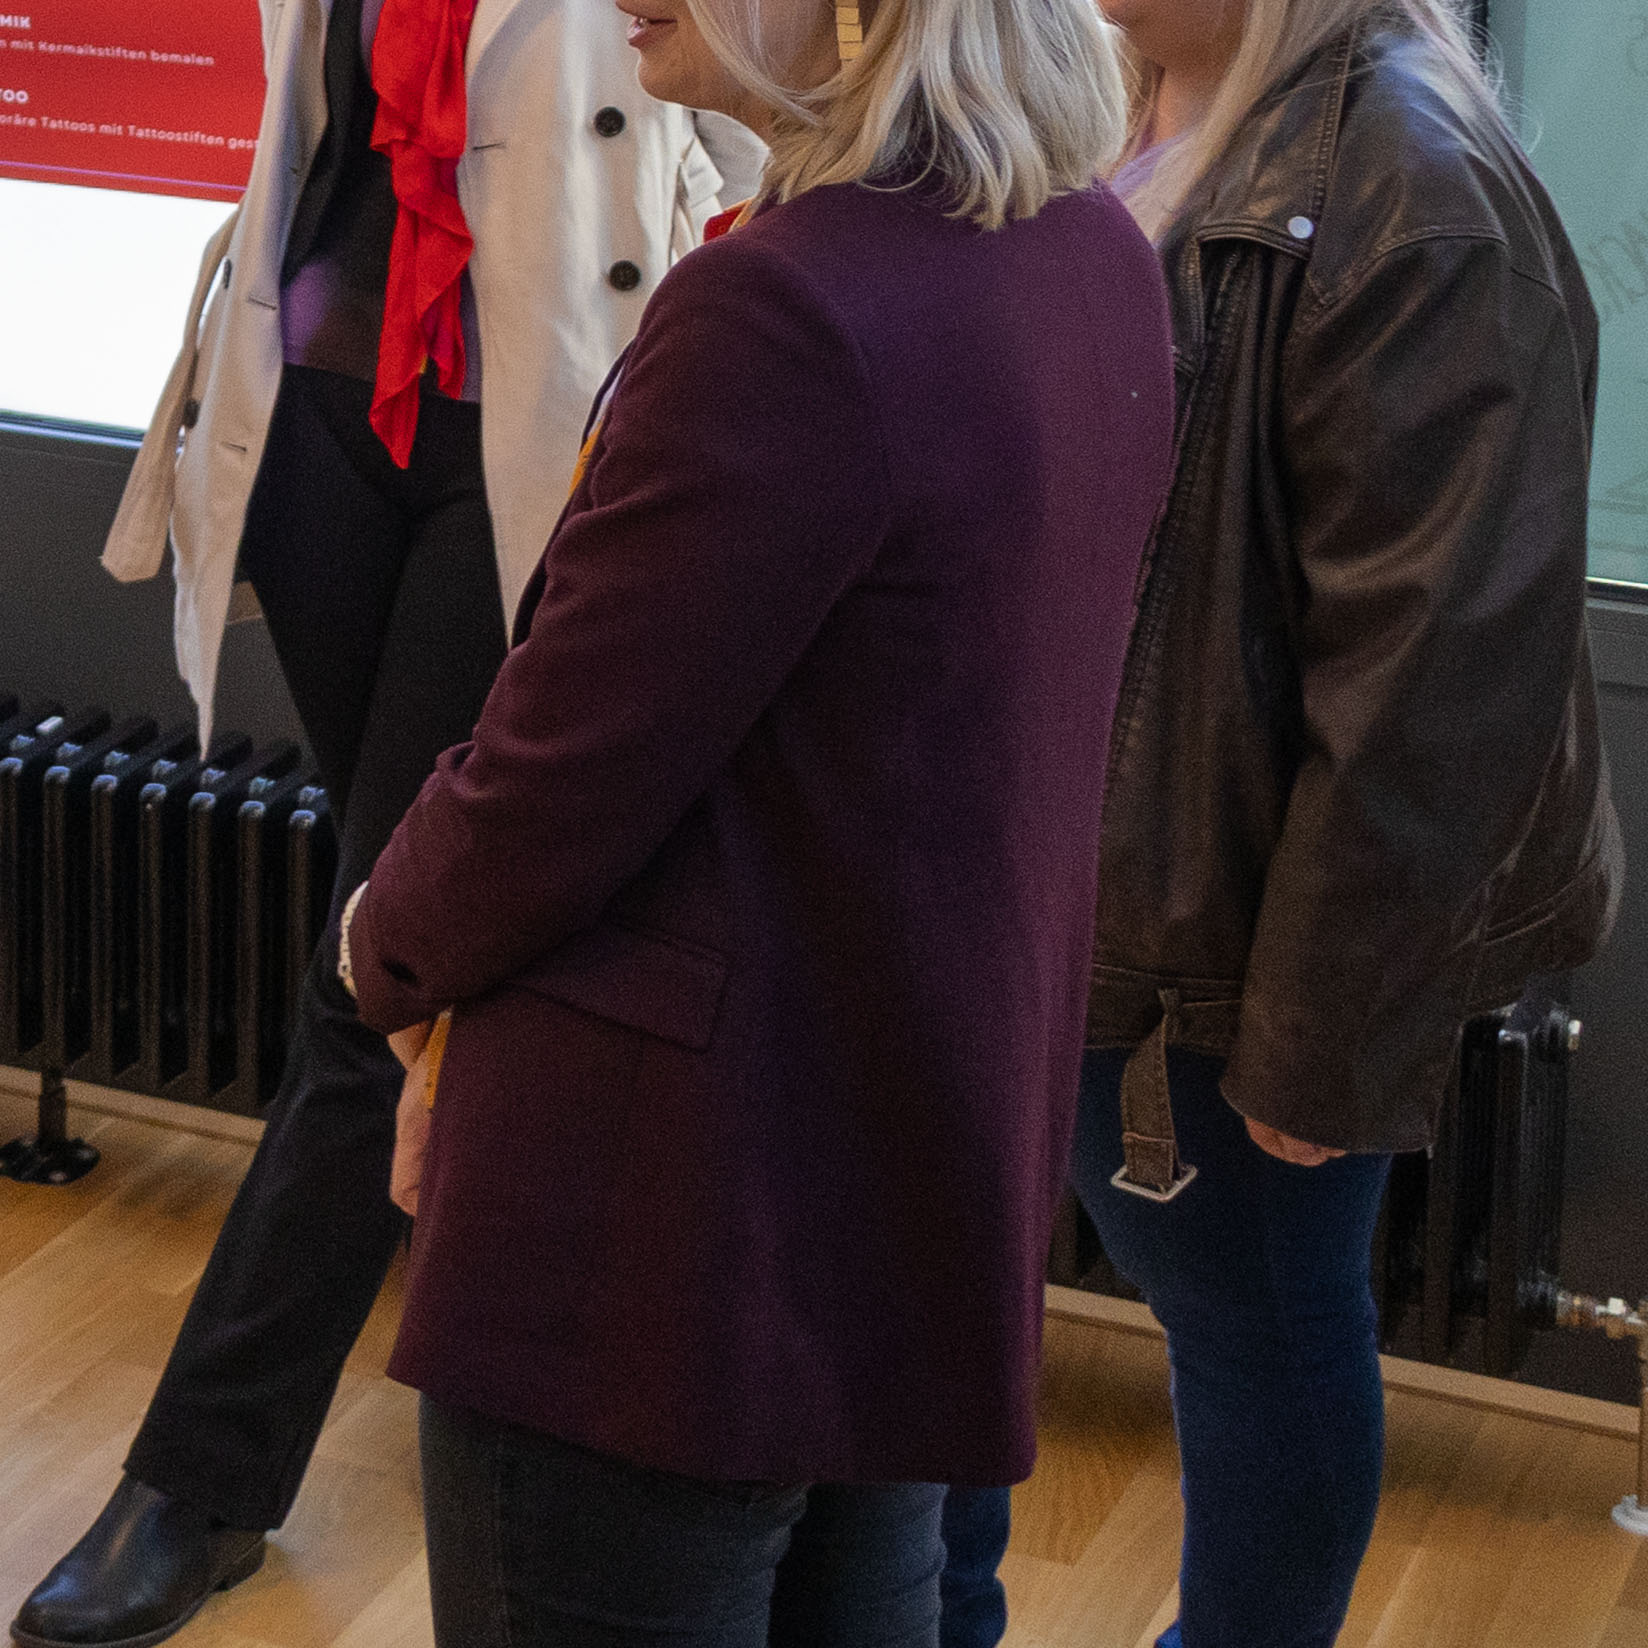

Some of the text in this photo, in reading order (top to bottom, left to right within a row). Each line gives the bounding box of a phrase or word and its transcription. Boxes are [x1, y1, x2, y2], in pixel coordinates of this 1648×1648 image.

[10, 40, 34, 50] mit
[150, 50, 214, 65] bemalen
[41, 116, 96, 133] Tattoos
[99, 124, 123, 135] mit
[128, 125, 225, 145] Tattoostiften
